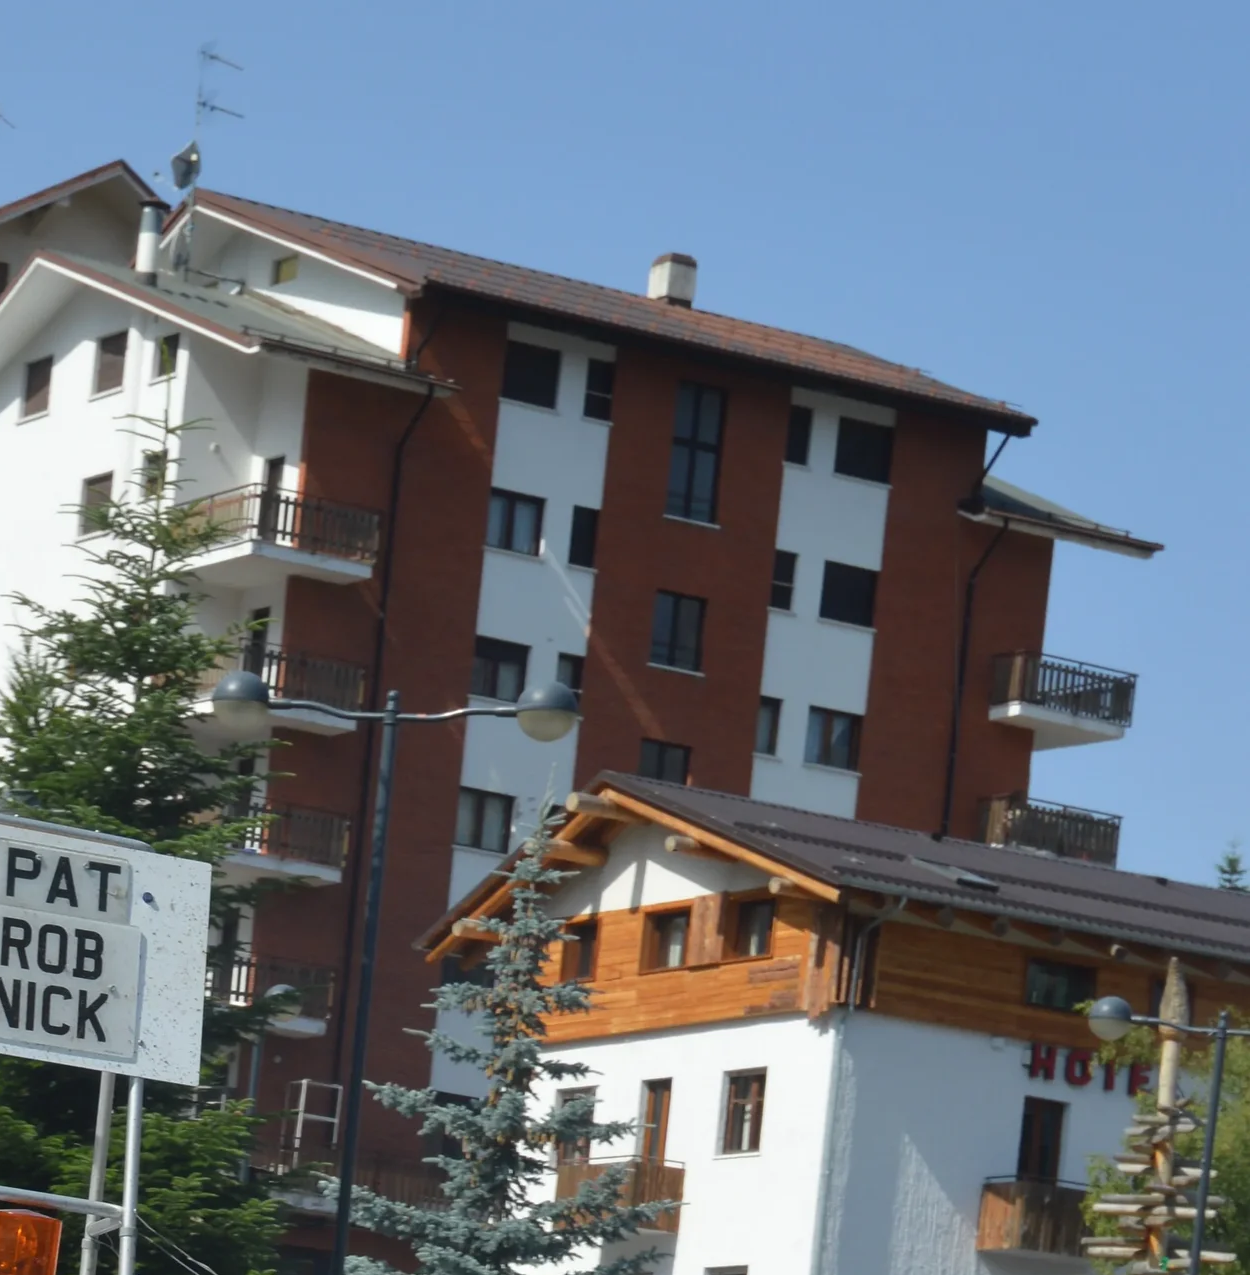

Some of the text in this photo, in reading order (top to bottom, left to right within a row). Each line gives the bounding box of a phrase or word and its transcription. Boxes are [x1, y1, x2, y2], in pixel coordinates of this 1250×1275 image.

[6, 847, 121, 912] PAT
[0, 916, 104, 980] ROB
[1028, 1042, 1152, 1097] HOTE
